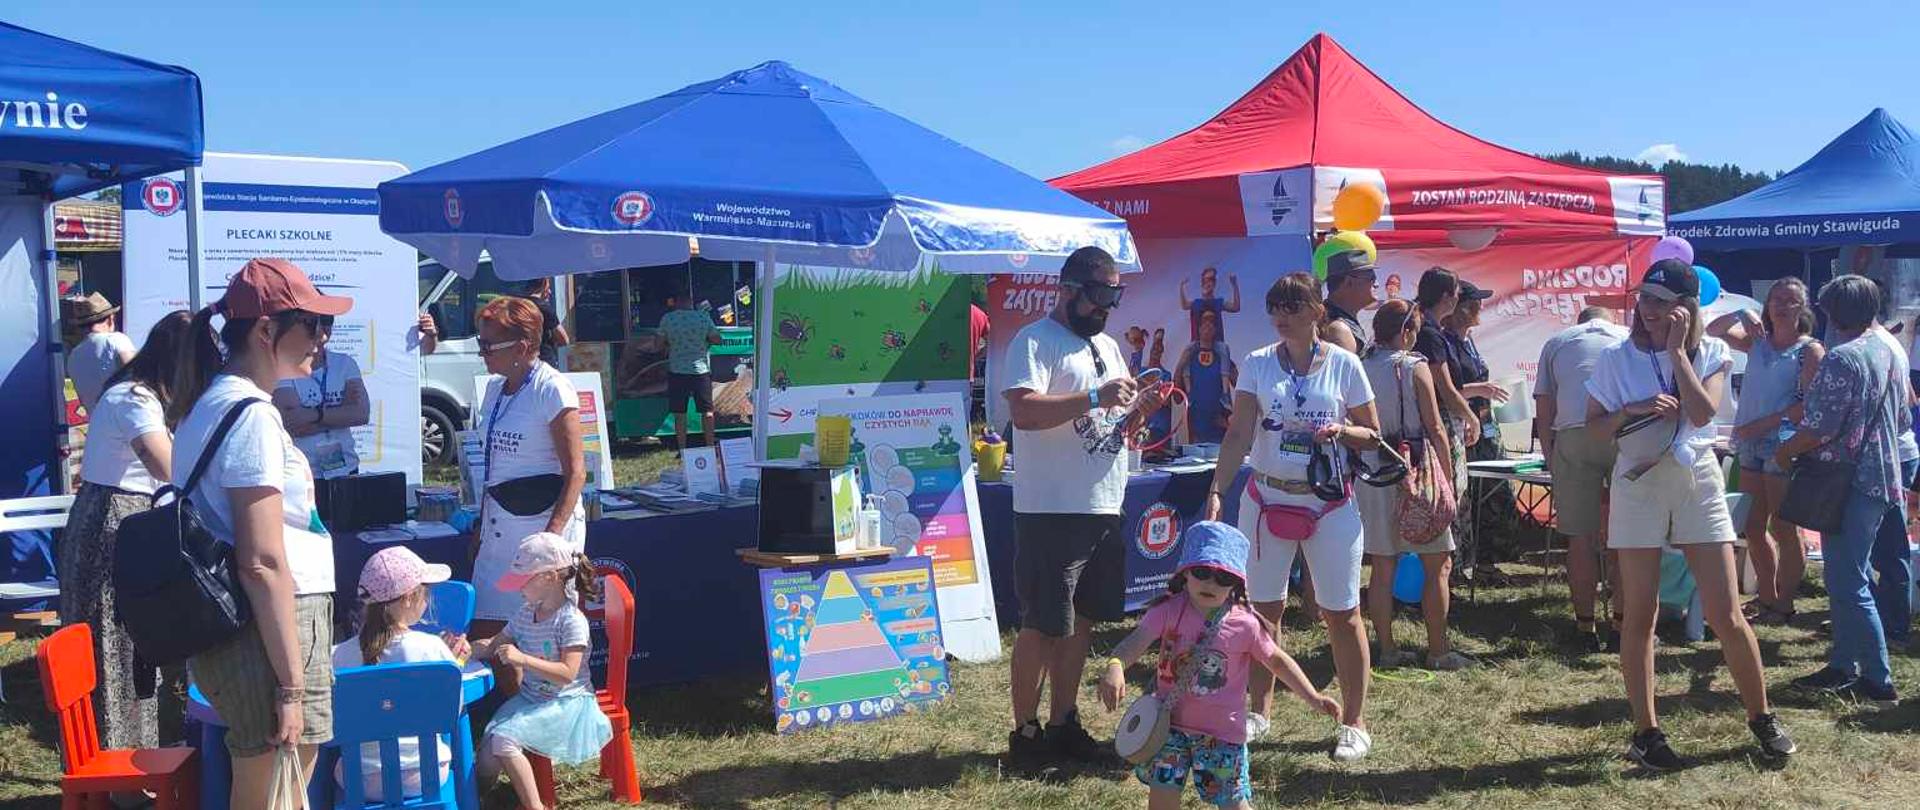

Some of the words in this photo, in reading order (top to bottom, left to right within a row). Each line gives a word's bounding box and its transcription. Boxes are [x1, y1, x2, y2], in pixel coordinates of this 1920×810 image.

[1114, 199, 1150, 216] NAMI
[1412, 188, 1466, 206] ZOSTAŃ
[1470, 189, 1526, 209] RODZINĄ
[1529, 191, 1596, 213] ZASTĘPCZĄ
[716, 203, 791, 217] Województwo
[692, 212, 811, 230] Warmińsko-Mazurskie
[1715, 225, 1770, 237] Zdrowia
[1774, 222, 1818, 237] Gminny
[1823, 216, 1900, 233] Stawiguda
[227, 229, 276, 240] PLECAKI
[279, 230, 333, 241] SZKOLNE
[308, 272, 337, 282] dzice?
[888, 409, 901, 419] DO
[864, 420, 911, 430] CZYSTYCH
